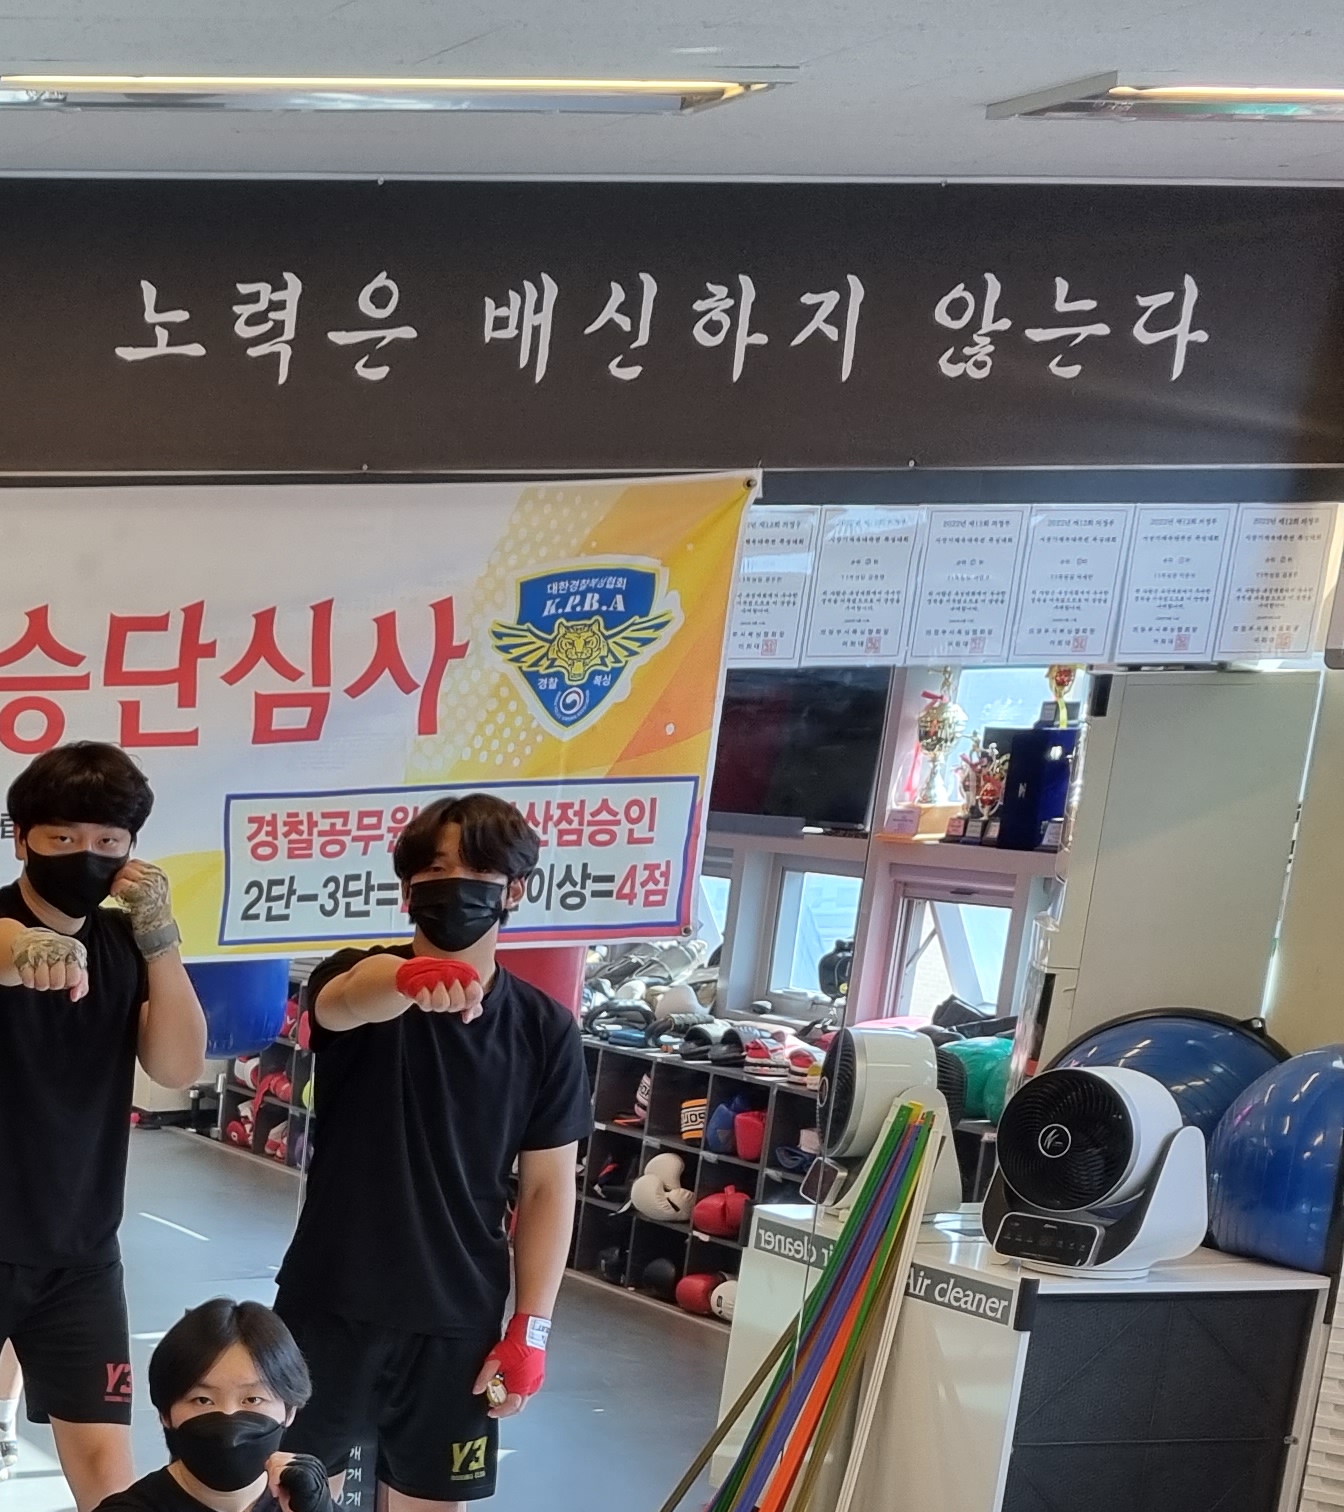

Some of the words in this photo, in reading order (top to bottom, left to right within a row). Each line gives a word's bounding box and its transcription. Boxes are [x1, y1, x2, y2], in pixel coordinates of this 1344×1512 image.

[114, 270, 419, 386] 노력은
[482, 272, 865, 384] 배신하지
[933, 272, 1210, 383] 않는다
[542, 593, 625, 617] K.P.B.A
[538, 677, 559, 690] 경찰
[935, 1278, 1009, 1320] cleaner
[452, 1436, 488, 1473] Y3
